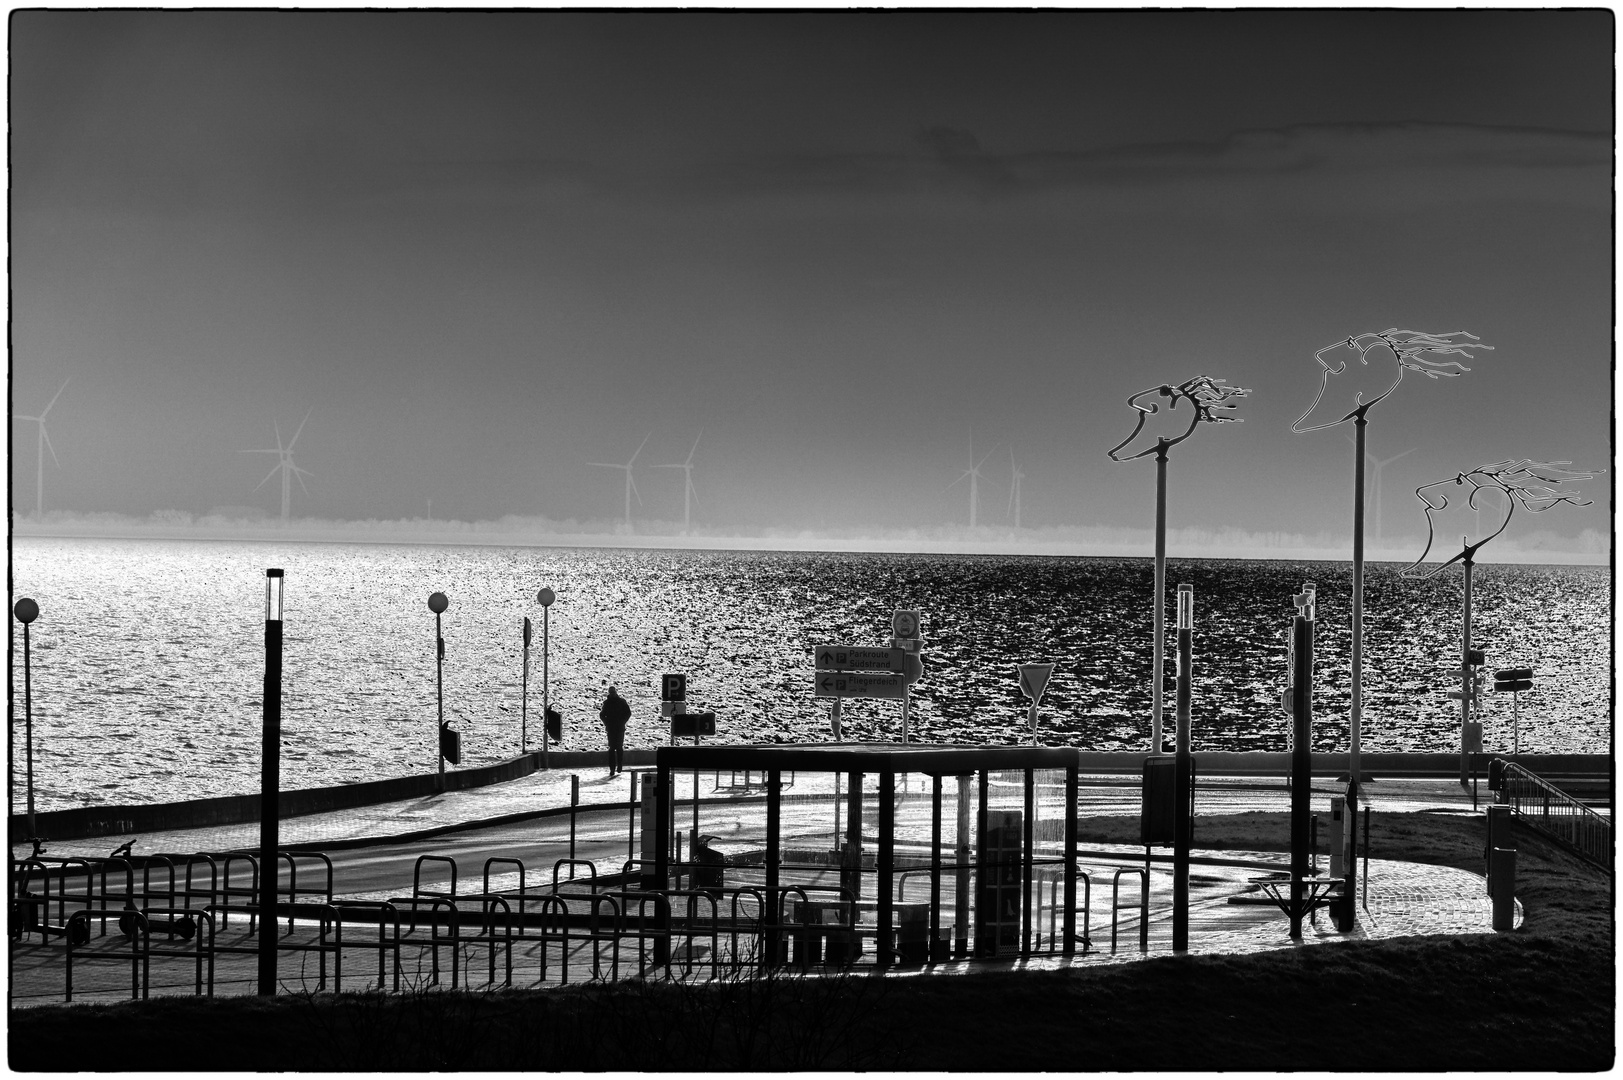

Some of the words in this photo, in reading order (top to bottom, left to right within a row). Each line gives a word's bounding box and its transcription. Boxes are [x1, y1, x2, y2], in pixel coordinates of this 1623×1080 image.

[849, 650, 889, 659] Parkroute
[849, 660, 891, 668] Südstrand
[848, 677, 898, 686] Fliegerdeich
[668, 678, 680, 698] P
